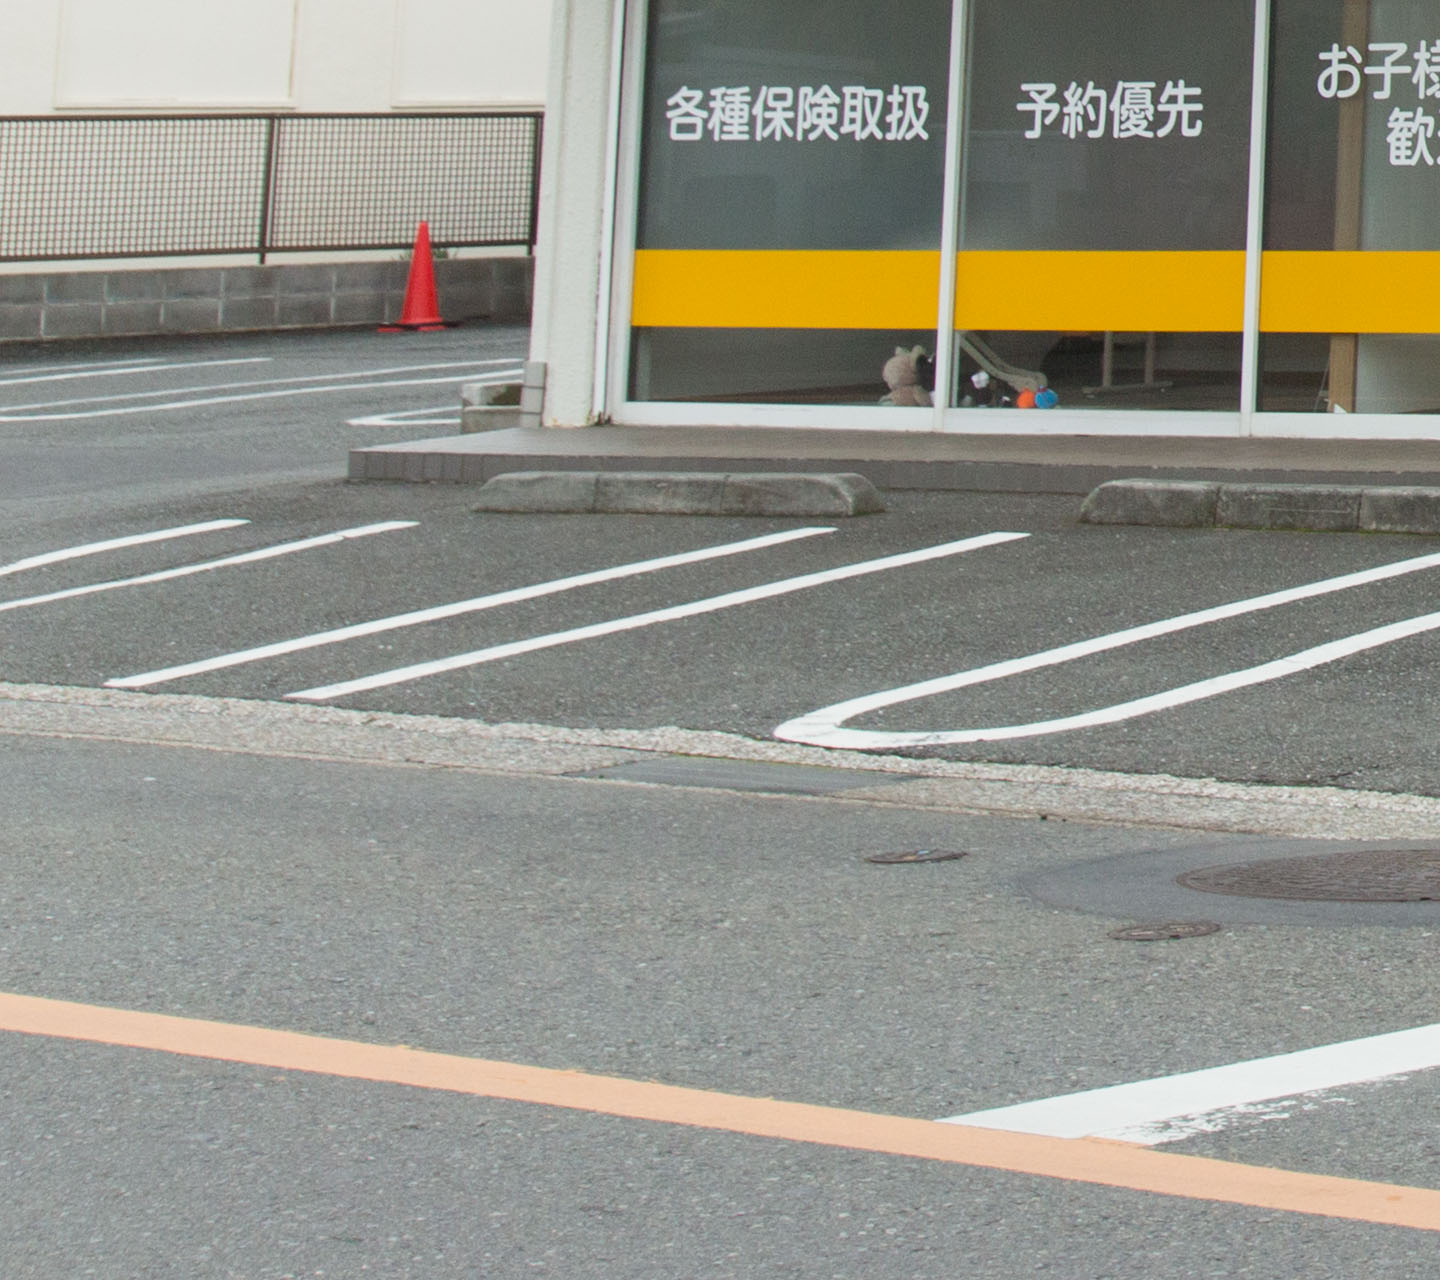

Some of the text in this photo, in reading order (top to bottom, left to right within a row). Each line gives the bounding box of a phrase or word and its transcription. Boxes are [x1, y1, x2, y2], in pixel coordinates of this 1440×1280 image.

[665, 84, 930, 142] 各種保険取扱
[1015, 79, 1204, 140] 予約優先
